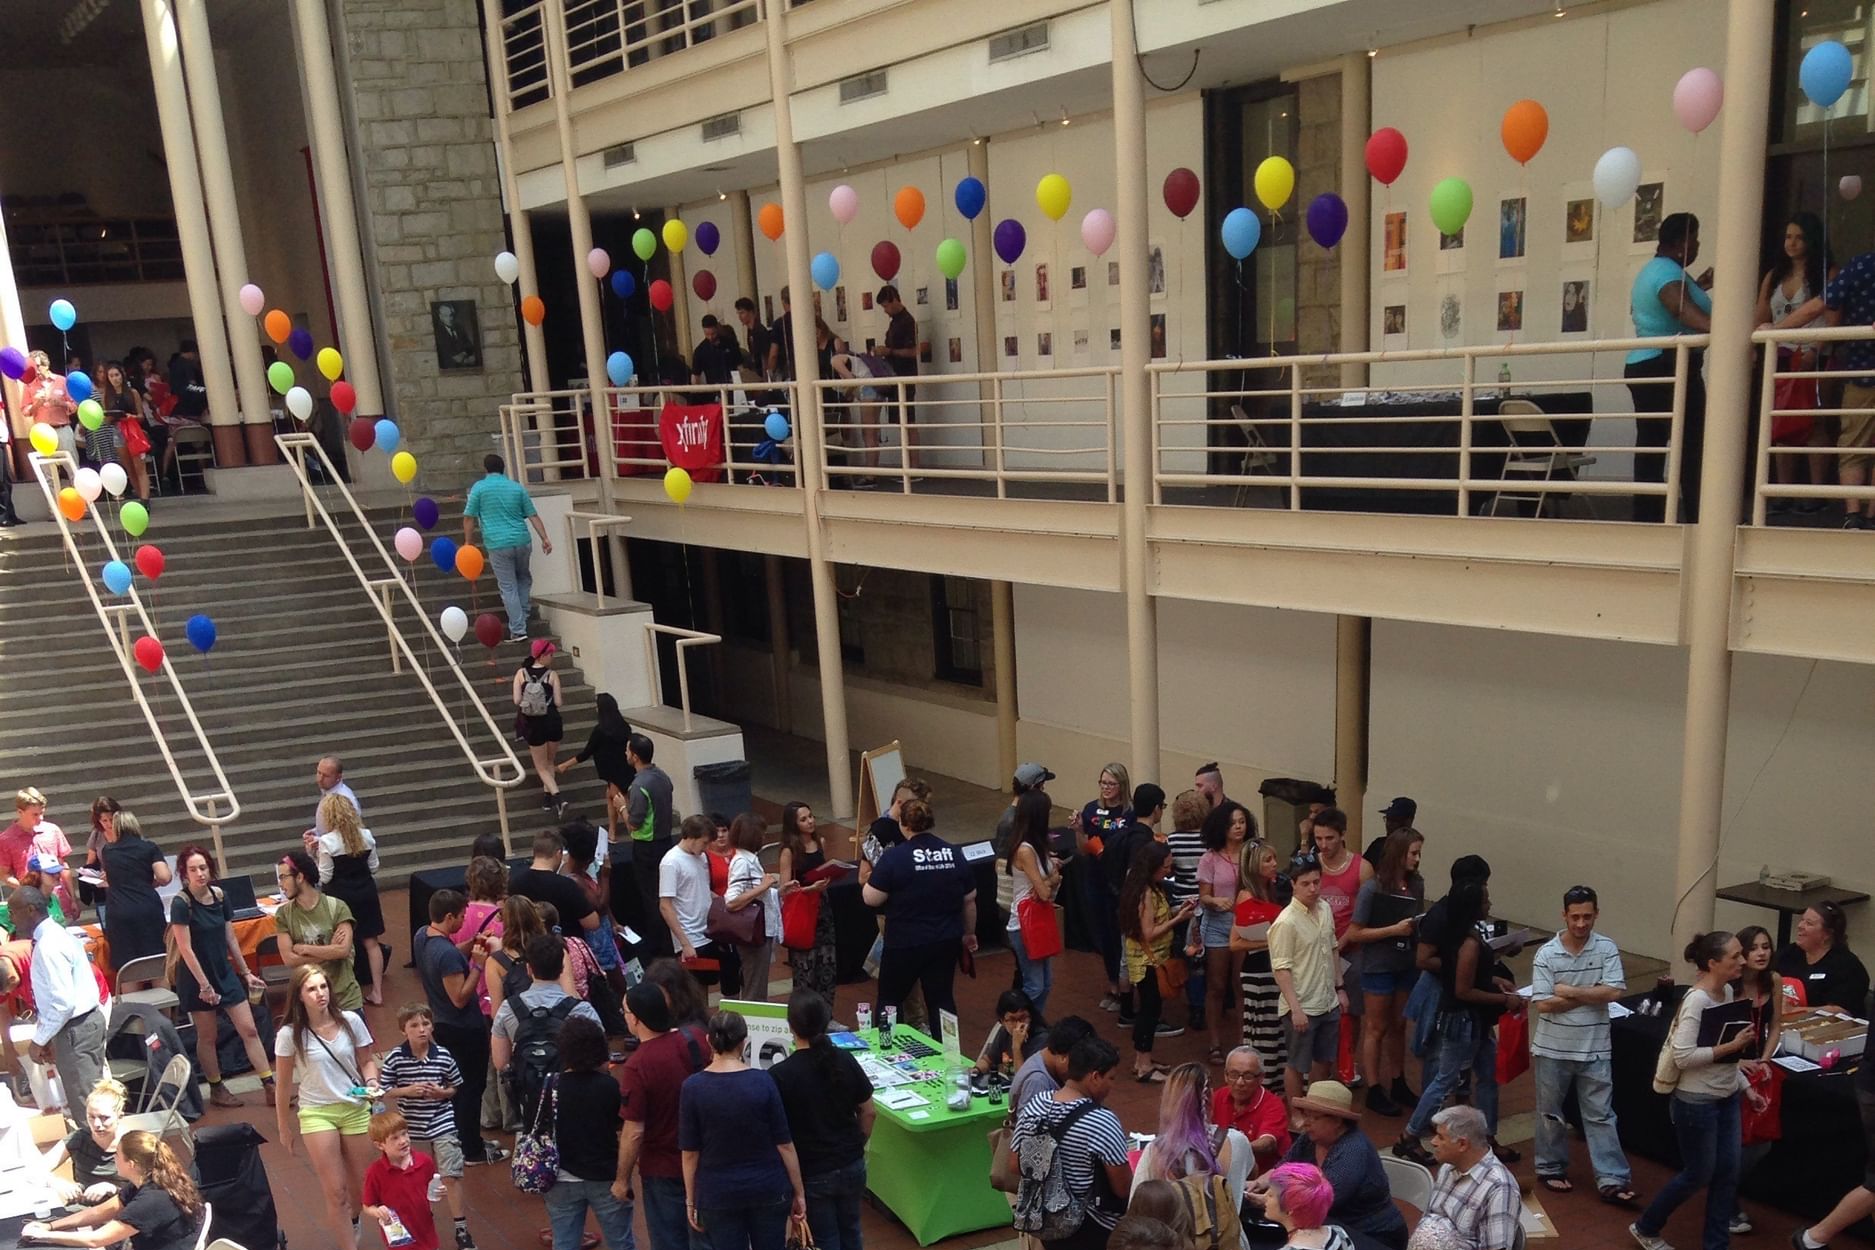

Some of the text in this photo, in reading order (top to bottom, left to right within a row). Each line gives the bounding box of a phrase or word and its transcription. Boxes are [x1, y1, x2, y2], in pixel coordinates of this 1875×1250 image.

[913, 847, 954, 862] Staff
[762, 1024, 770, 1032] to
[771, 1025, 782, 1034] zip
